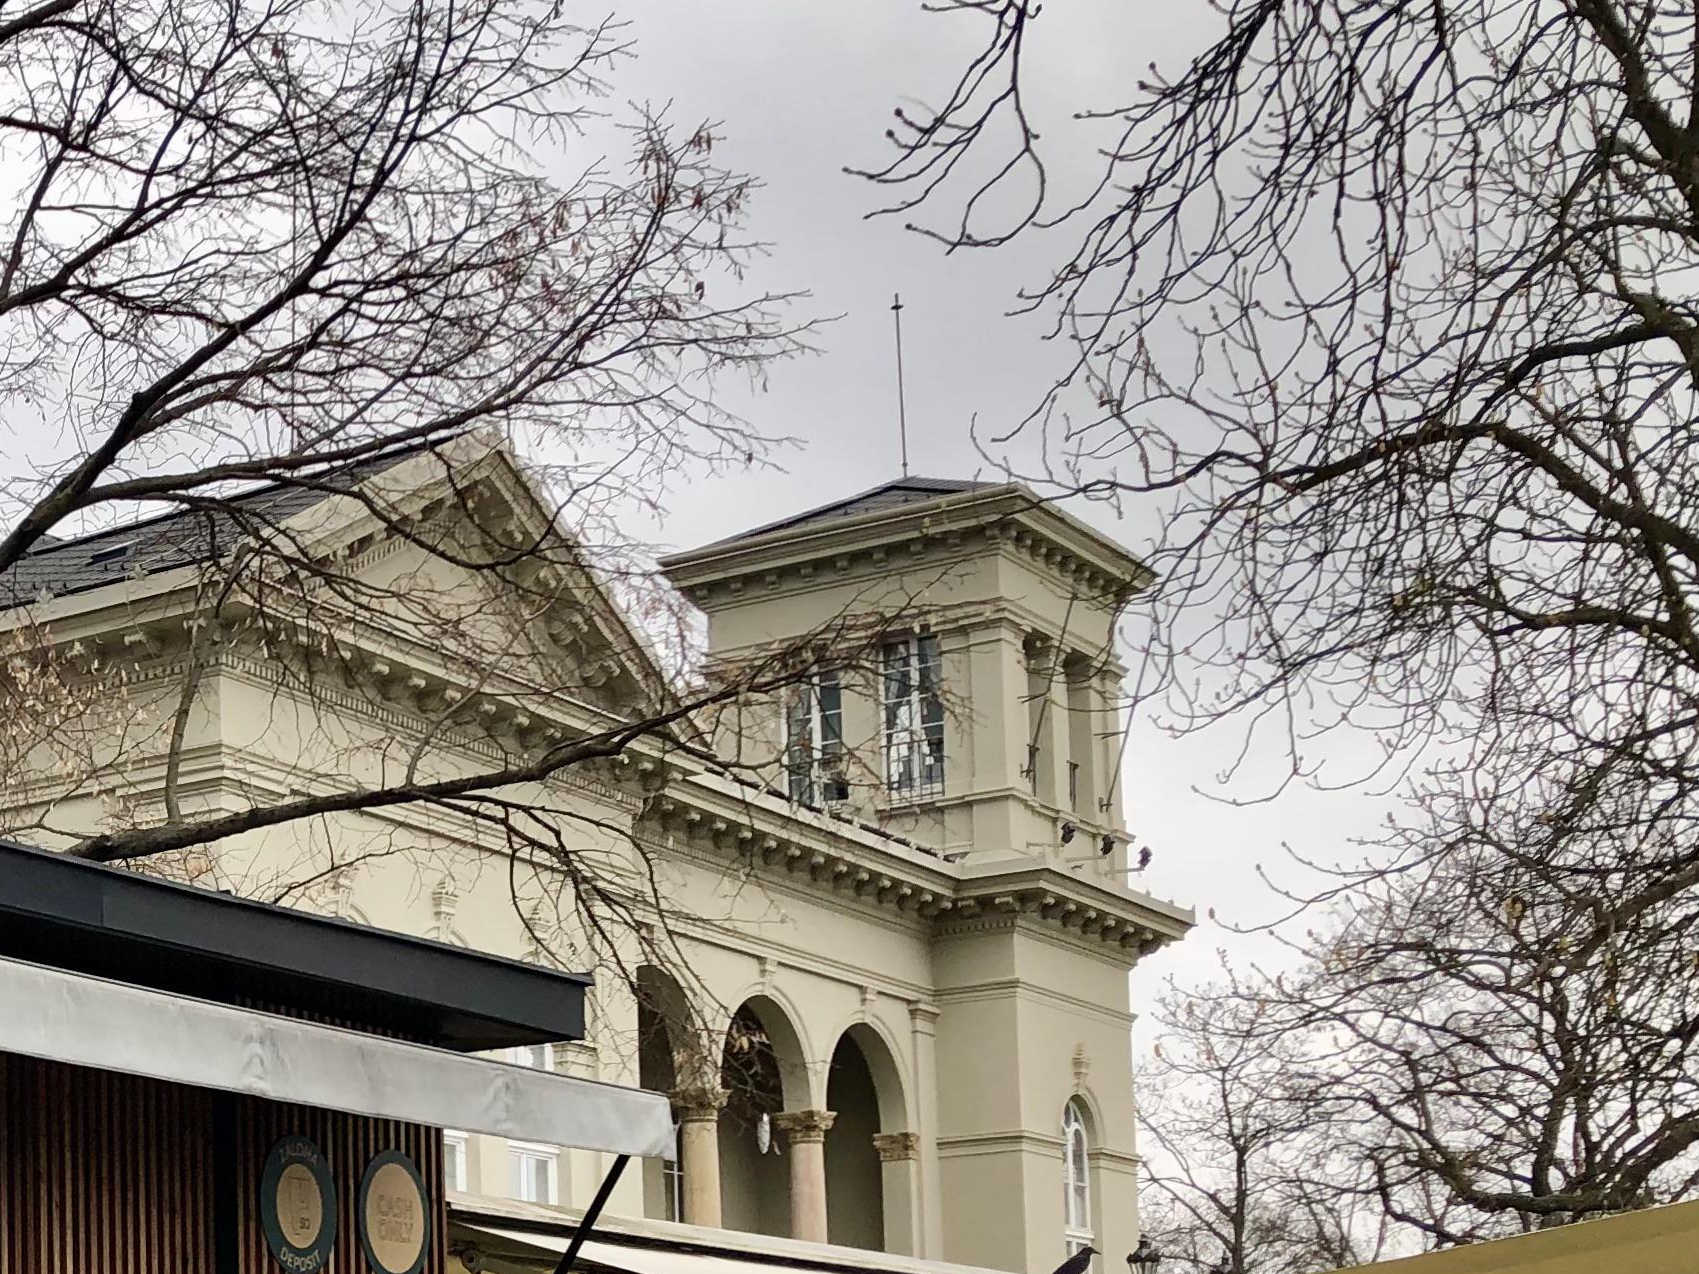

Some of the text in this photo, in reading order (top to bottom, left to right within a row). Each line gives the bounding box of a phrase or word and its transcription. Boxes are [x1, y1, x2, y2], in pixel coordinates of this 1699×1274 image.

[378, 1194, 414, 1219] CASH
[378, 1219, 414, 1243] ONLY
[280, 1247, 321, 1272] DEPOSIT
